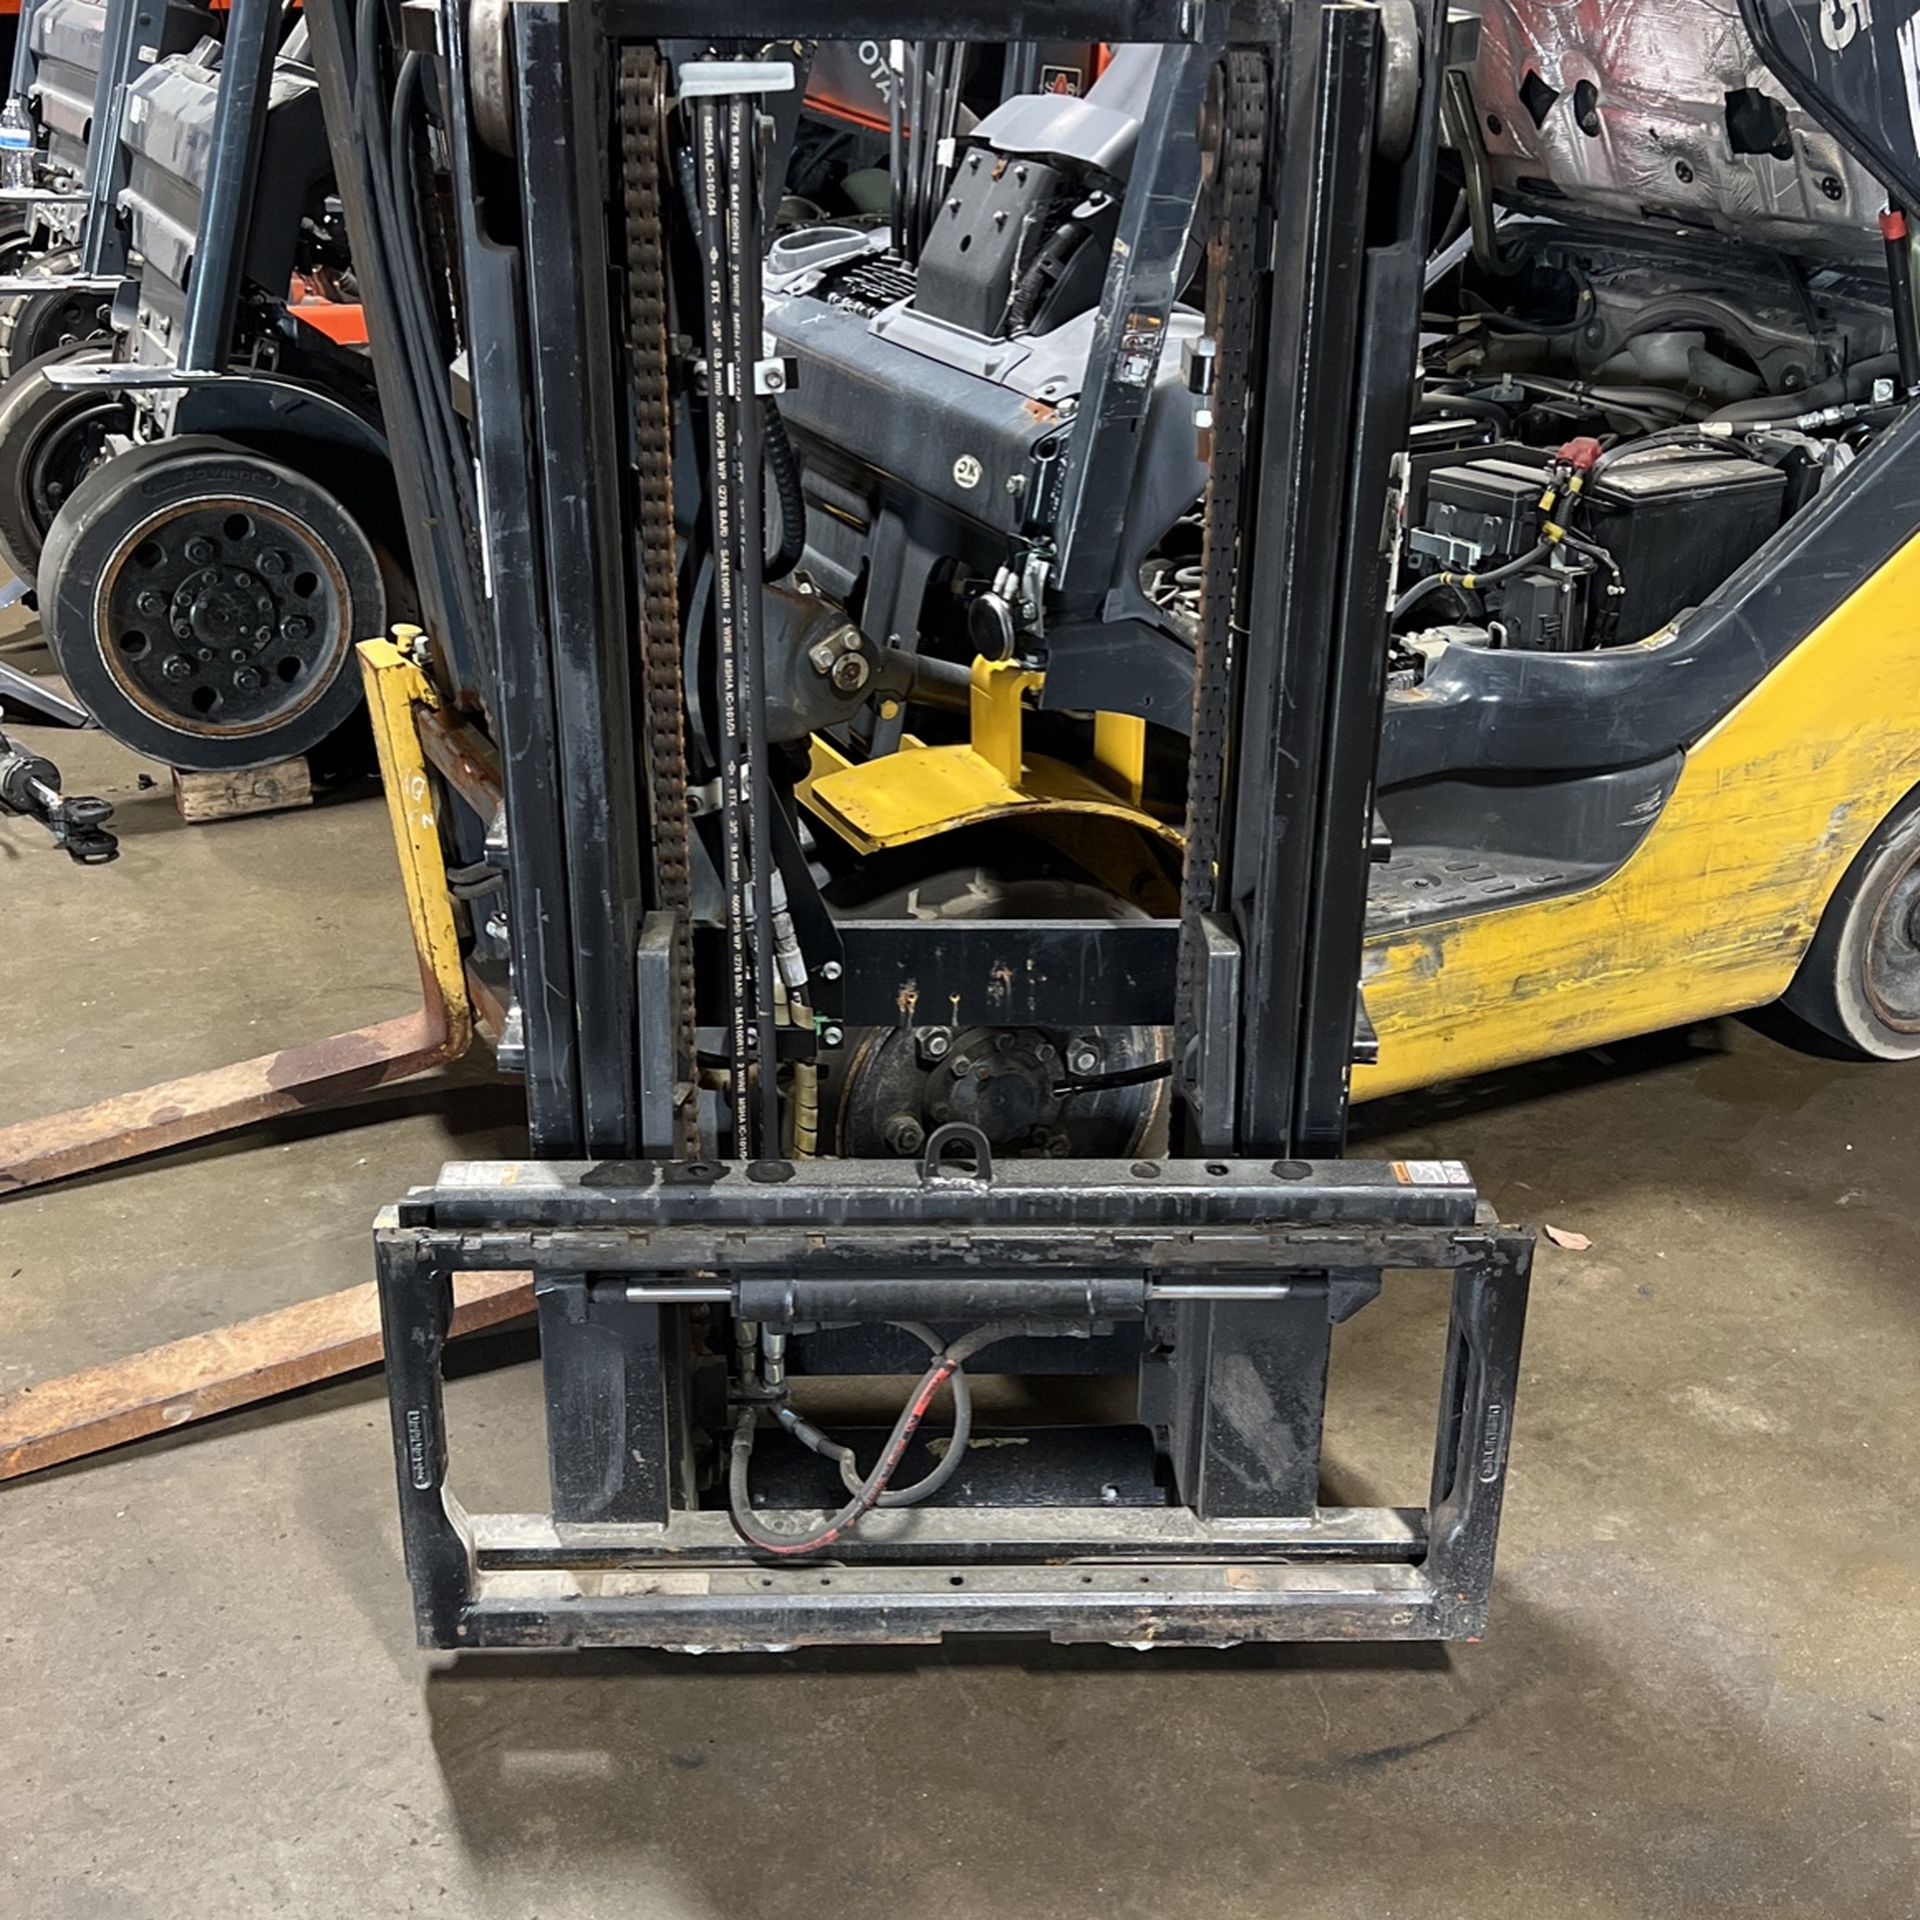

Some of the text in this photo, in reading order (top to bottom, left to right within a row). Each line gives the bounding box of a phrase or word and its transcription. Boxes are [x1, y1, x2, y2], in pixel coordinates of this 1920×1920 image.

[716, 411, 725, 438] 4000
[717, 440, 726, 460] PSI
[717, 462, 726, 480] WP
[719, 549, 731, 609] SAE100R16
[723, 626, 732, 653] WIRE
[724, 659, 733, 689] MSHA
